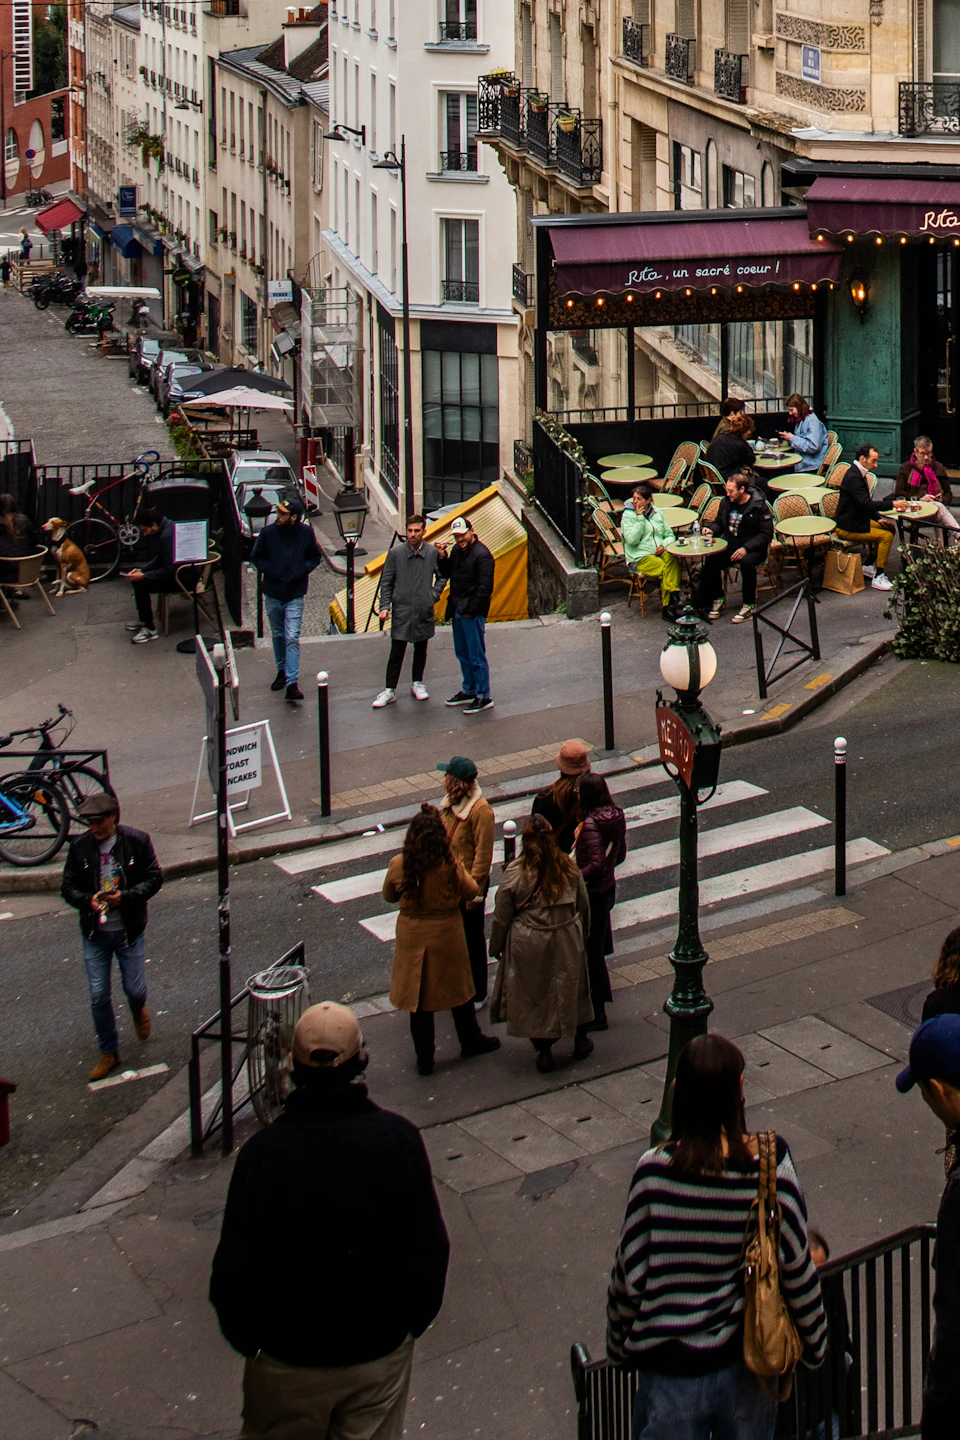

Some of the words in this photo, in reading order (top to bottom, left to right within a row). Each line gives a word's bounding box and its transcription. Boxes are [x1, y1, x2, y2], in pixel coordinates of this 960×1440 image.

[672, 269, 690, 278] un
[695, 264, 730, 278] sacré
[736, 264, 771, 274] coeur
[226, 741, 258, 757] NDWICH
[226, 770, 258, 786] NCAKES
